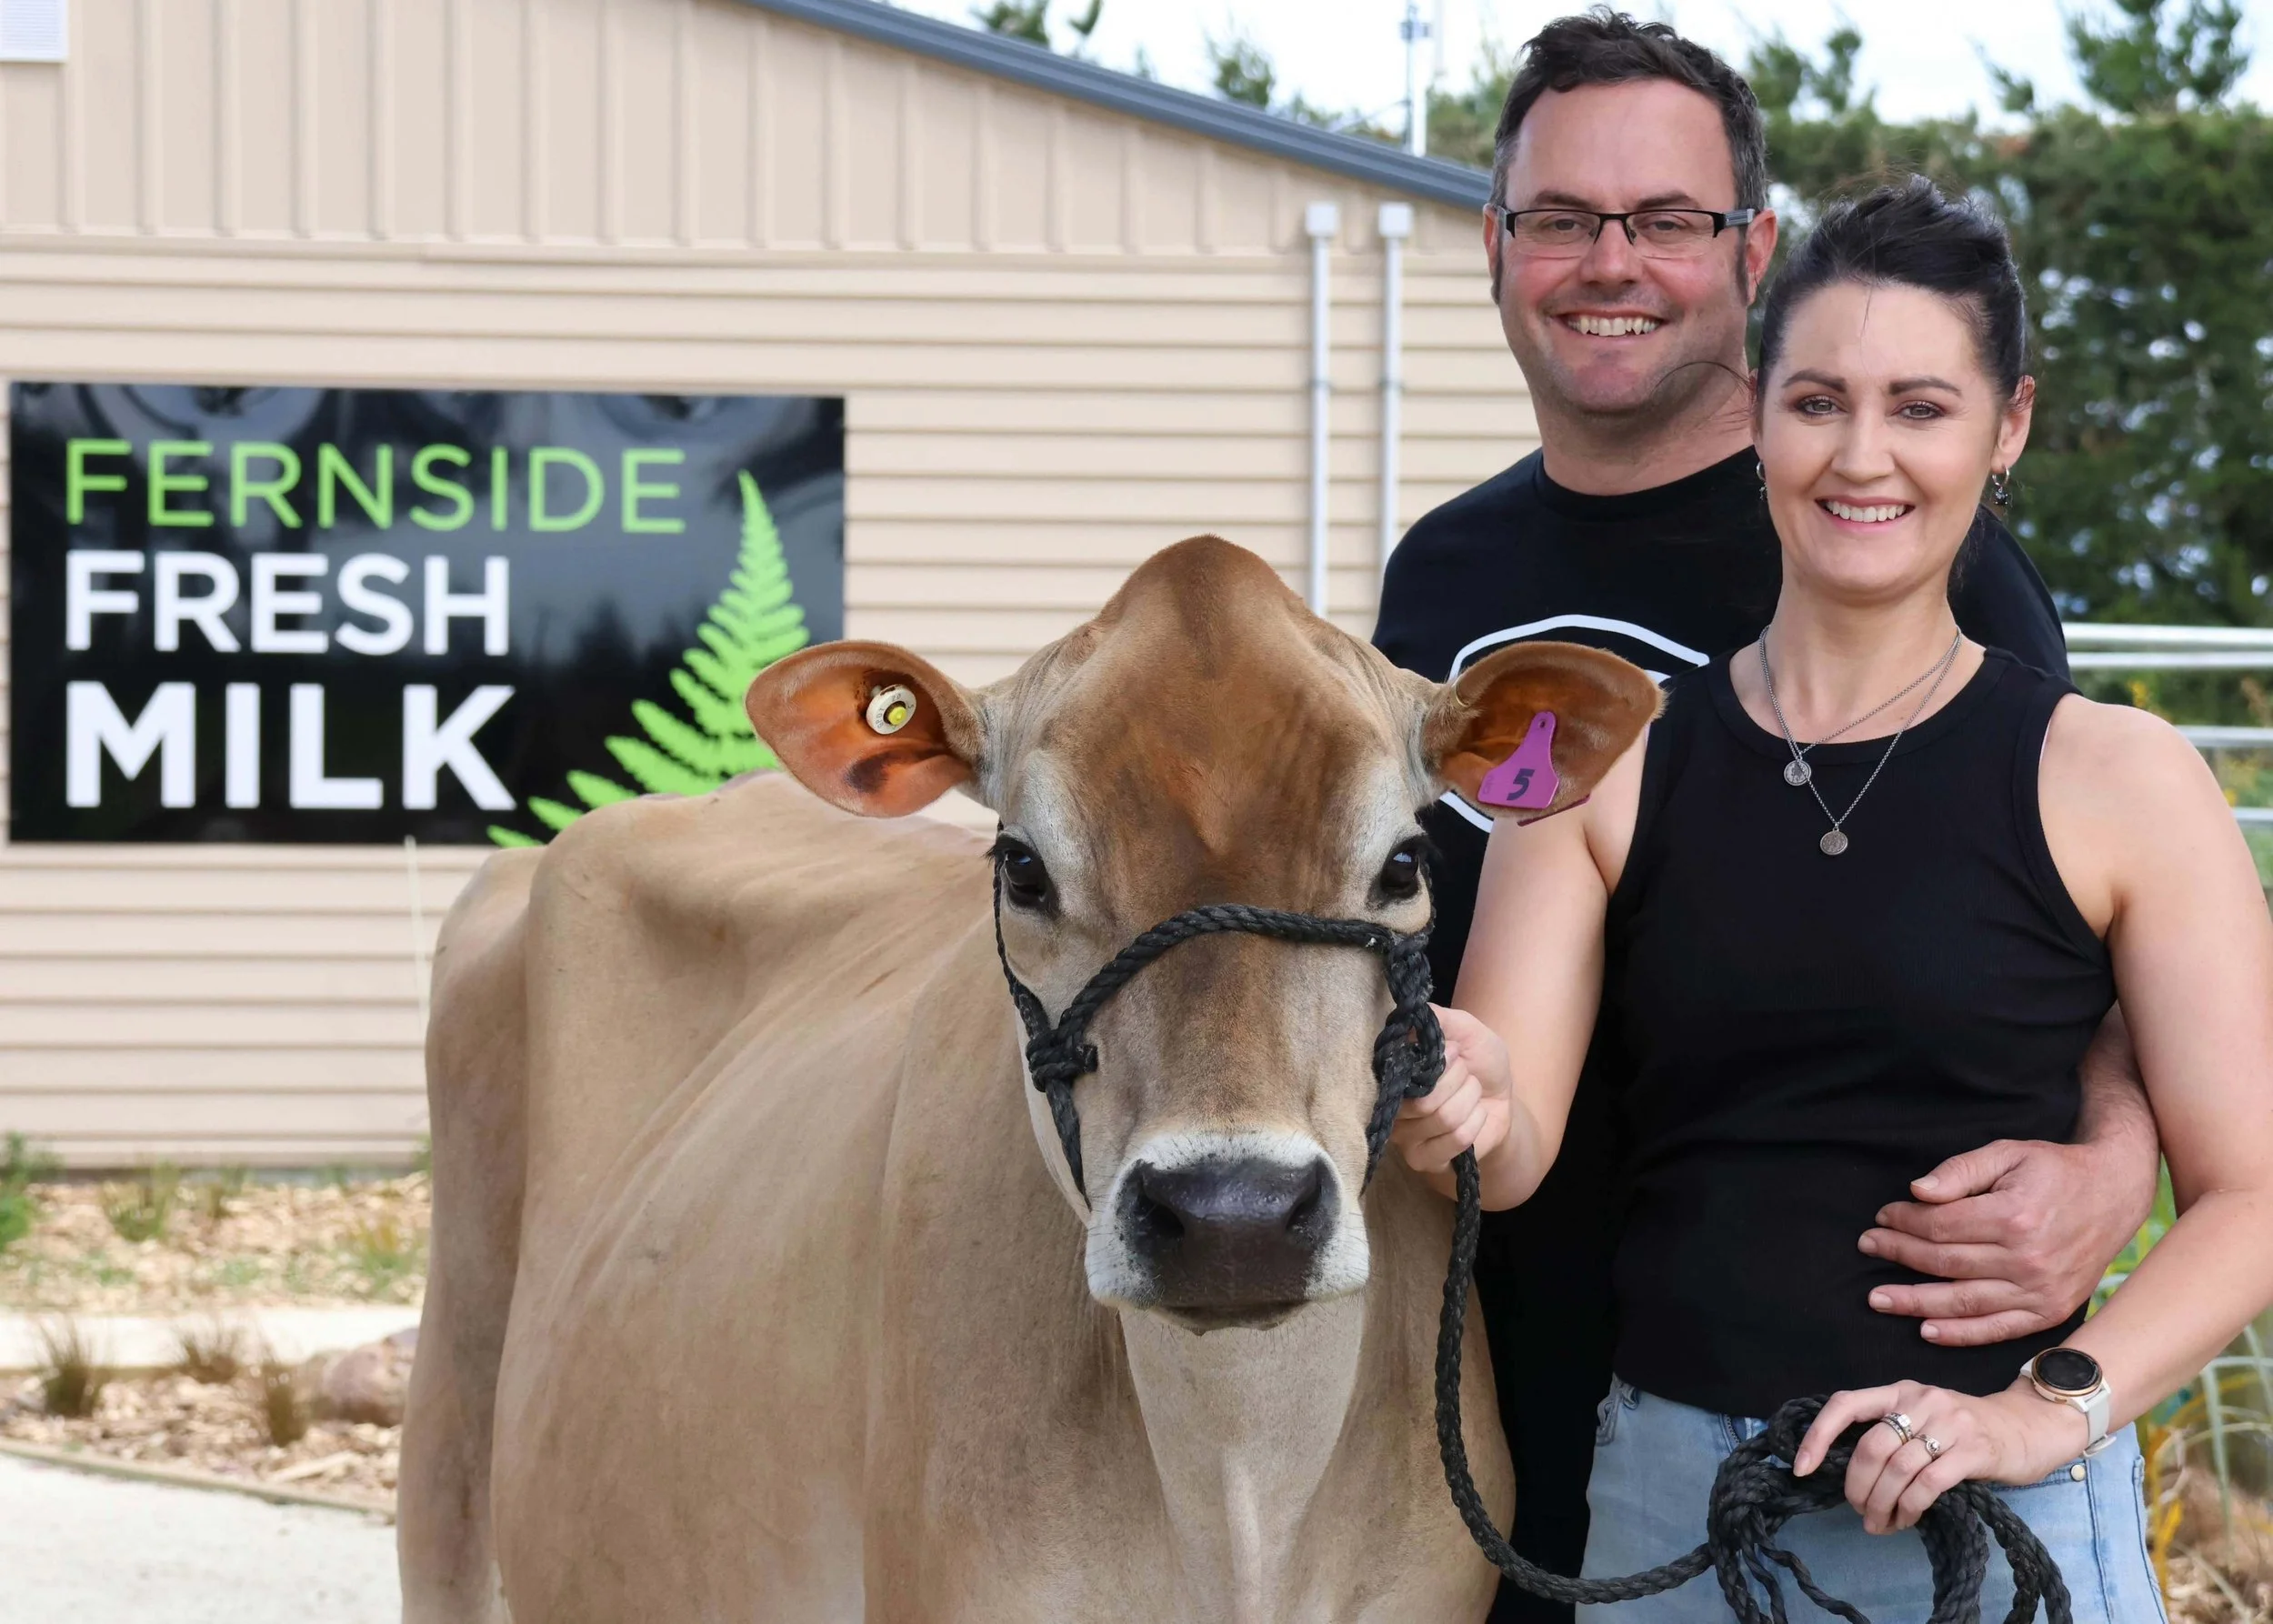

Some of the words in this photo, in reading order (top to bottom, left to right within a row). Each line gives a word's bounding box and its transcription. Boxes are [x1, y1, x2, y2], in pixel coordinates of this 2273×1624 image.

[66, 438, 686, 533] FERNSIDE
[65, 549, 510, 656] FRESH
[65, 681, 516, 810] MILK
[1506, 767, 1537, 801] 5
